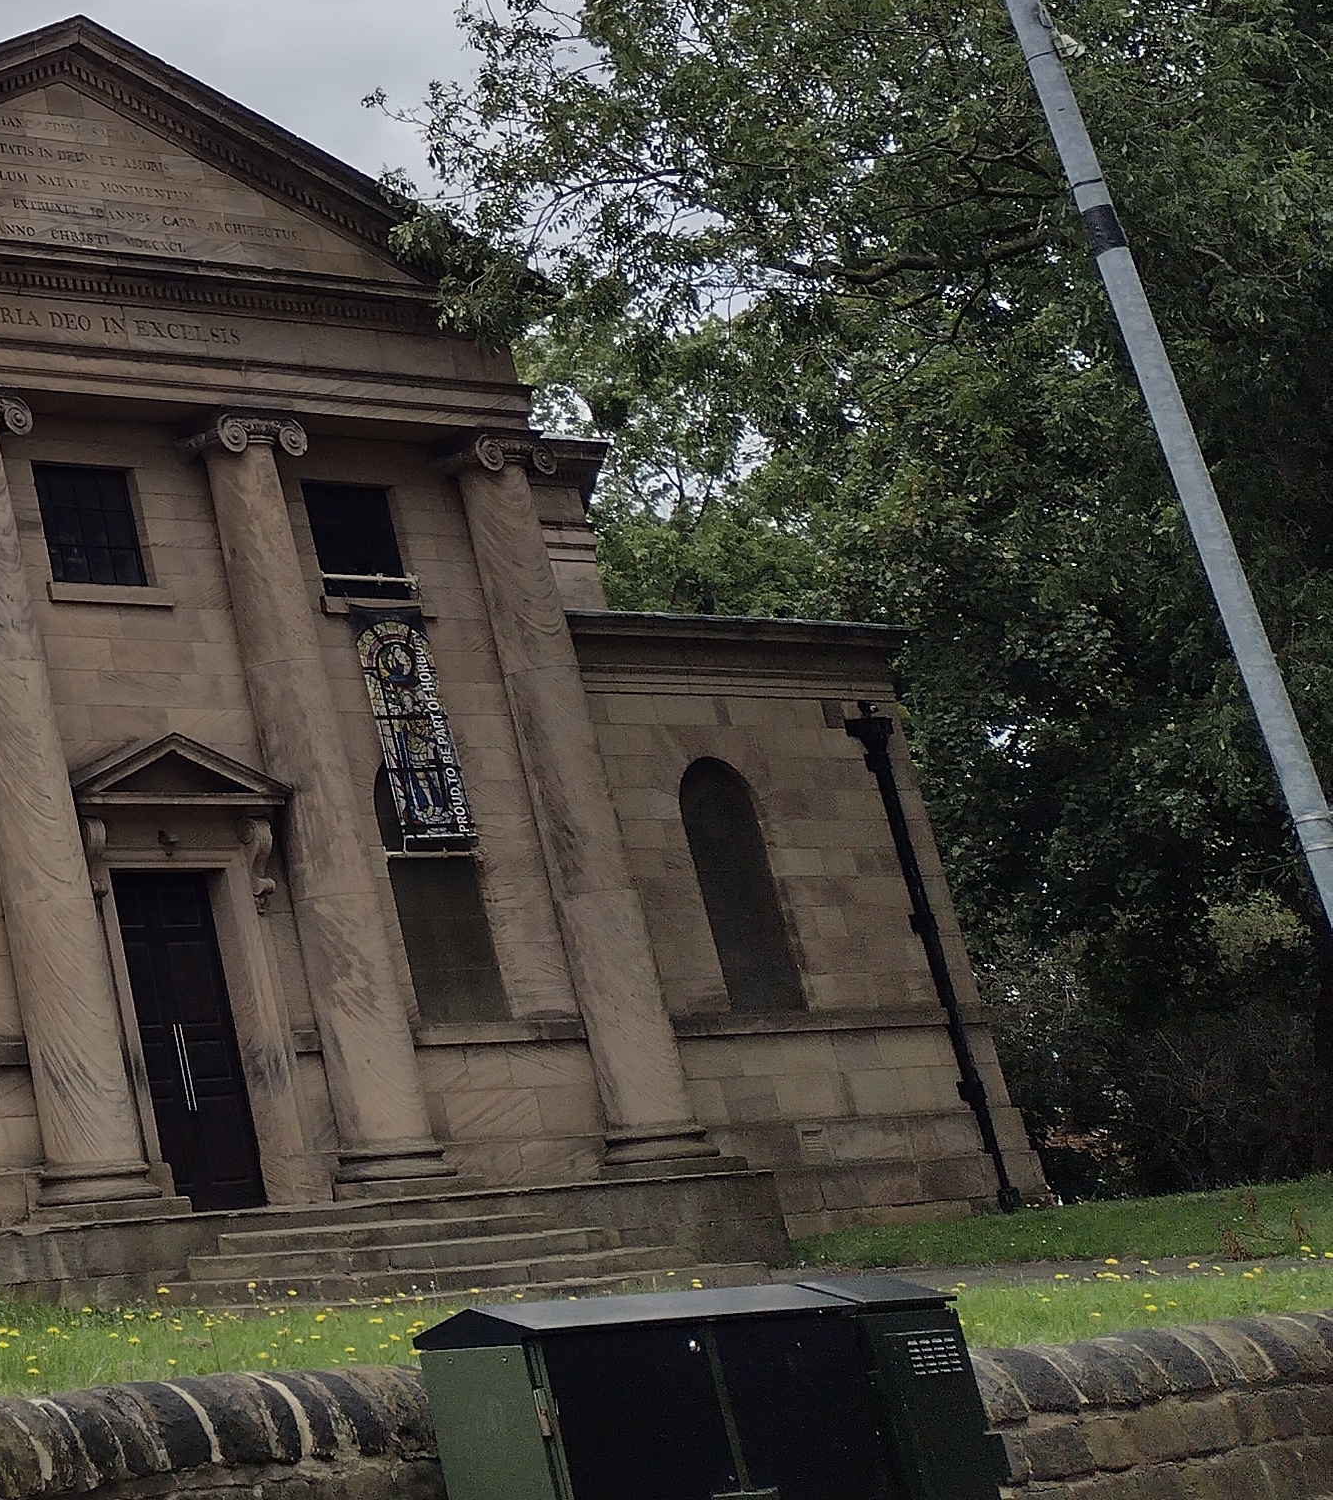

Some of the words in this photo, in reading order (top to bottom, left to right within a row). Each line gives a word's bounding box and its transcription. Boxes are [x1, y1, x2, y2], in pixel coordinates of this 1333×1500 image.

[39, 148, 53, 159] IN
[58, 150, 96, 164] DEUM
[101, 156, 117, 167] ET
[122, 159, 170, 174] AMORIS
[36, 174, 90, 190] NATALE
[50, 229, 110, 245] CHRISTI
[48, 311, 91, 332] DEO
[102, 316, 125, 335] IN
[134, 319, 241, 346] EXCELSIS
[411, 629, 435, 691] HORBURY
[425, 693, 440, 711] OF
[431, 714, 449, 745] PART
[440, 748, 453, 764] BE
[445, 767, 457, 785] TO
[450, 787, 469, 833] PROUD
